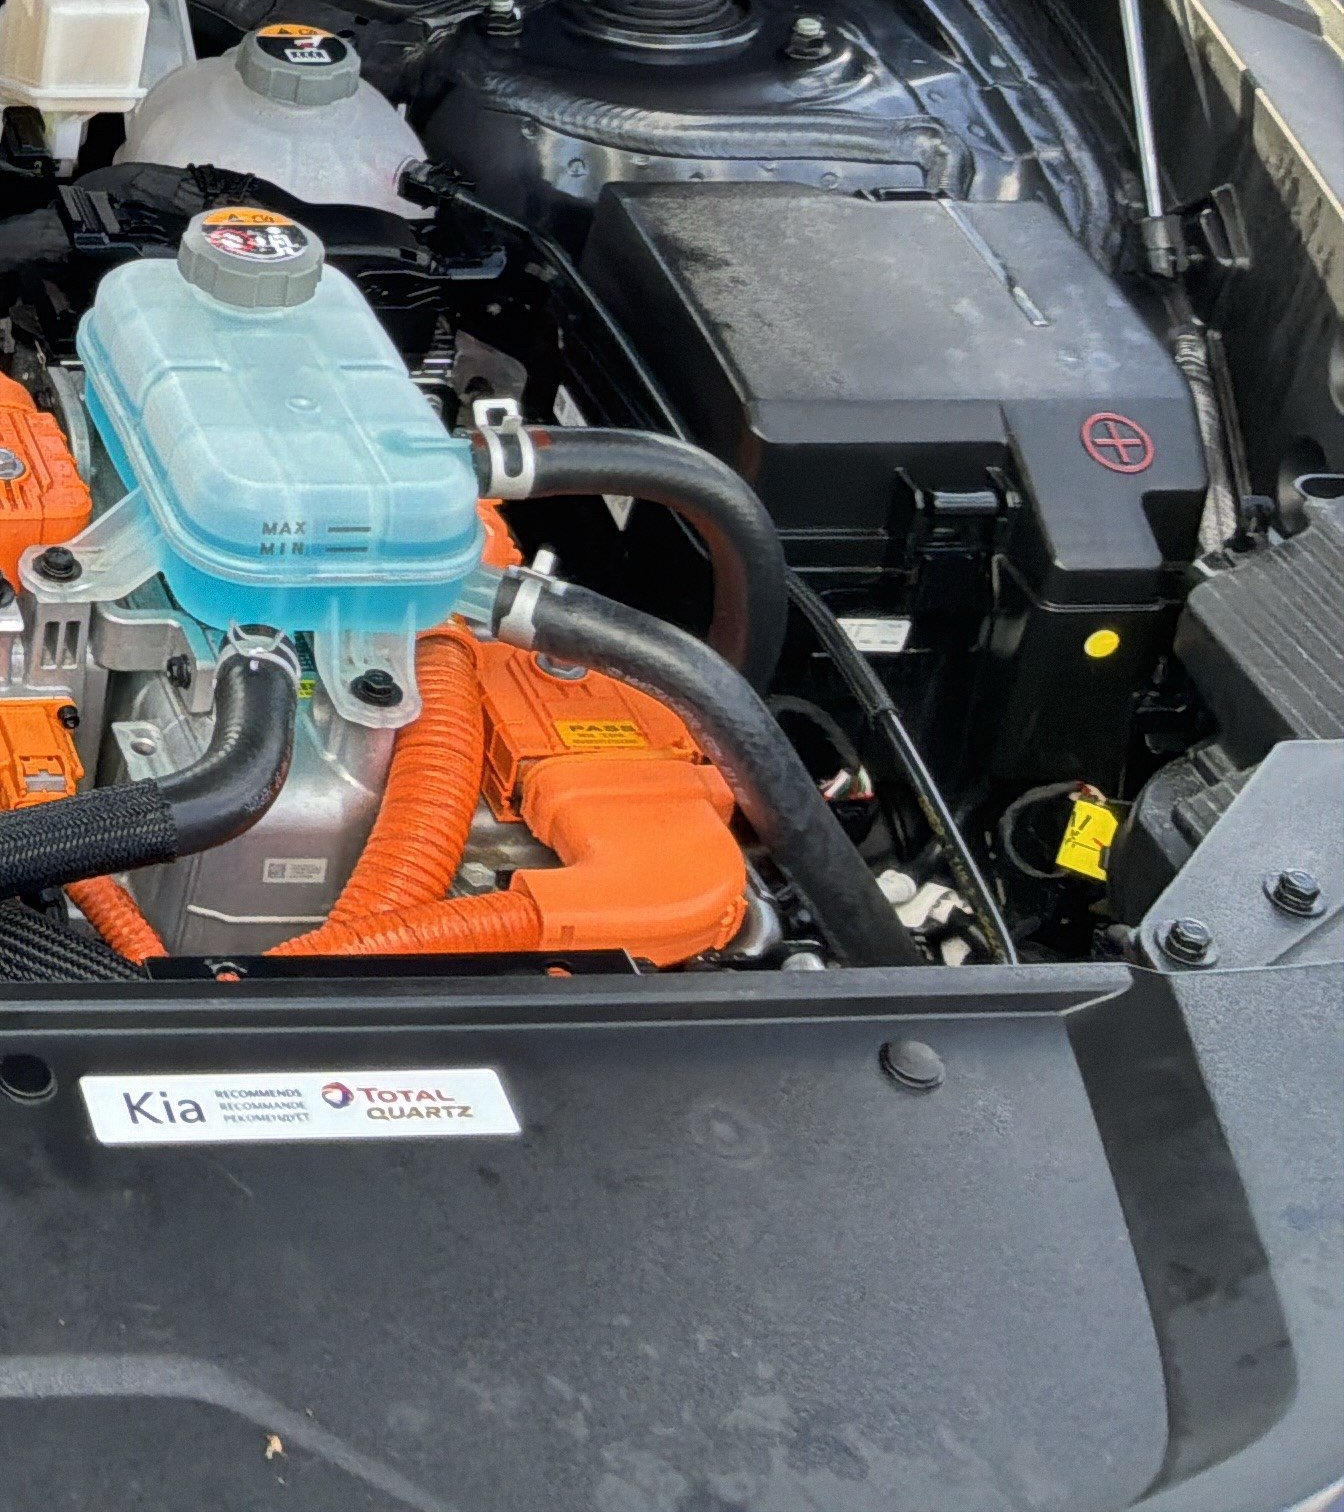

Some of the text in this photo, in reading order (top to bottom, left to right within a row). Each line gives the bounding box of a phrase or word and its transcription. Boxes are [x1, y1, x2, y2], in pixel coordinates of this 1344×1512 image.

[262, 521, 306, 535] MAX
[260, 542, 305, 556] MIN
[214, 1088, 303, 1099] RECOMMENDS
[356, 1087, 455, 1103] TOTAL
[123, 1091, 206, 1125] Kia
[218, 1100, 307, 1112] RECOMMANDE
[366, 1105, 474, 1121] QUARTZ
